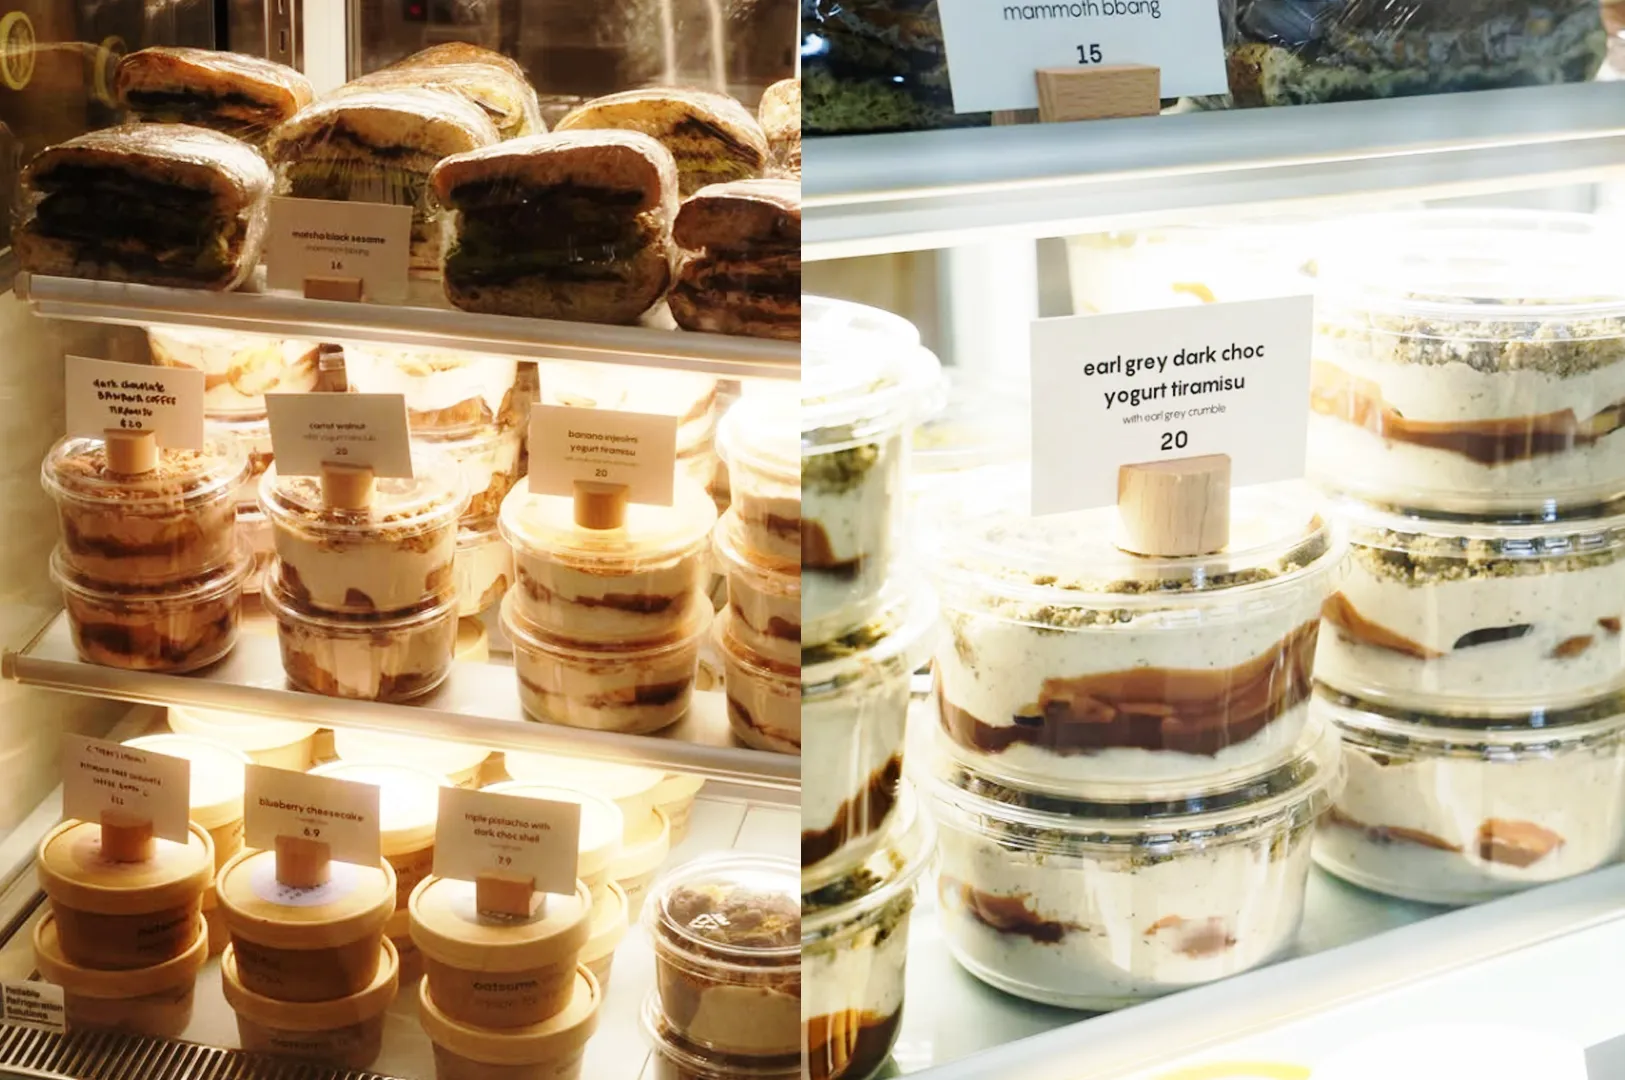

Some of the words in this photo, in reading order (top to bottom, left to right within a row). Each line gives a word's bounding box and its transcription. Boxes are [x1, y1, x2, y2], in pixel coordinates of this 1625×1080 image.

[1003, 0, 1099, 20] mammoth
[1102, 0, 1162, 19] bbang
[1076, 44, 1103, 64] 15
[331, 261, 343, 270] 16
[1083, 355, 1121, 376] earl
[1125, 355, 1168, 377] grey
[1173, 346, 1217, 366] dark
[1221, 343, 1265, 361] choc
[1104, 383, 1168, 409] yogurt
[1171, 375, 1245, 397] tiramisu
[1122, 413, 1143, 424] with
[1144, 410, 1164, 422] earl
[1164, 410, 1186, 422] grey
[1188, 403, 1227, 417] crumble
[568, 430, 604, 441] banana
[1160, 430, 1189, 451] 20
[570, 444, 600, 454] yogurt
[600, 446, 636, 456] tiramisu
[594, 468, 608, 478] 20
[258, 797, 304, 813] blueberry
[306, 805, 364, 822] cheesecake
[488, 816, 529, 828] pistachio
[531, 822, 551, 831] with
[473, 828, 495, 837] dark
[496, 830, 517, 840] choc
[519, 833, 540, 843] shell
